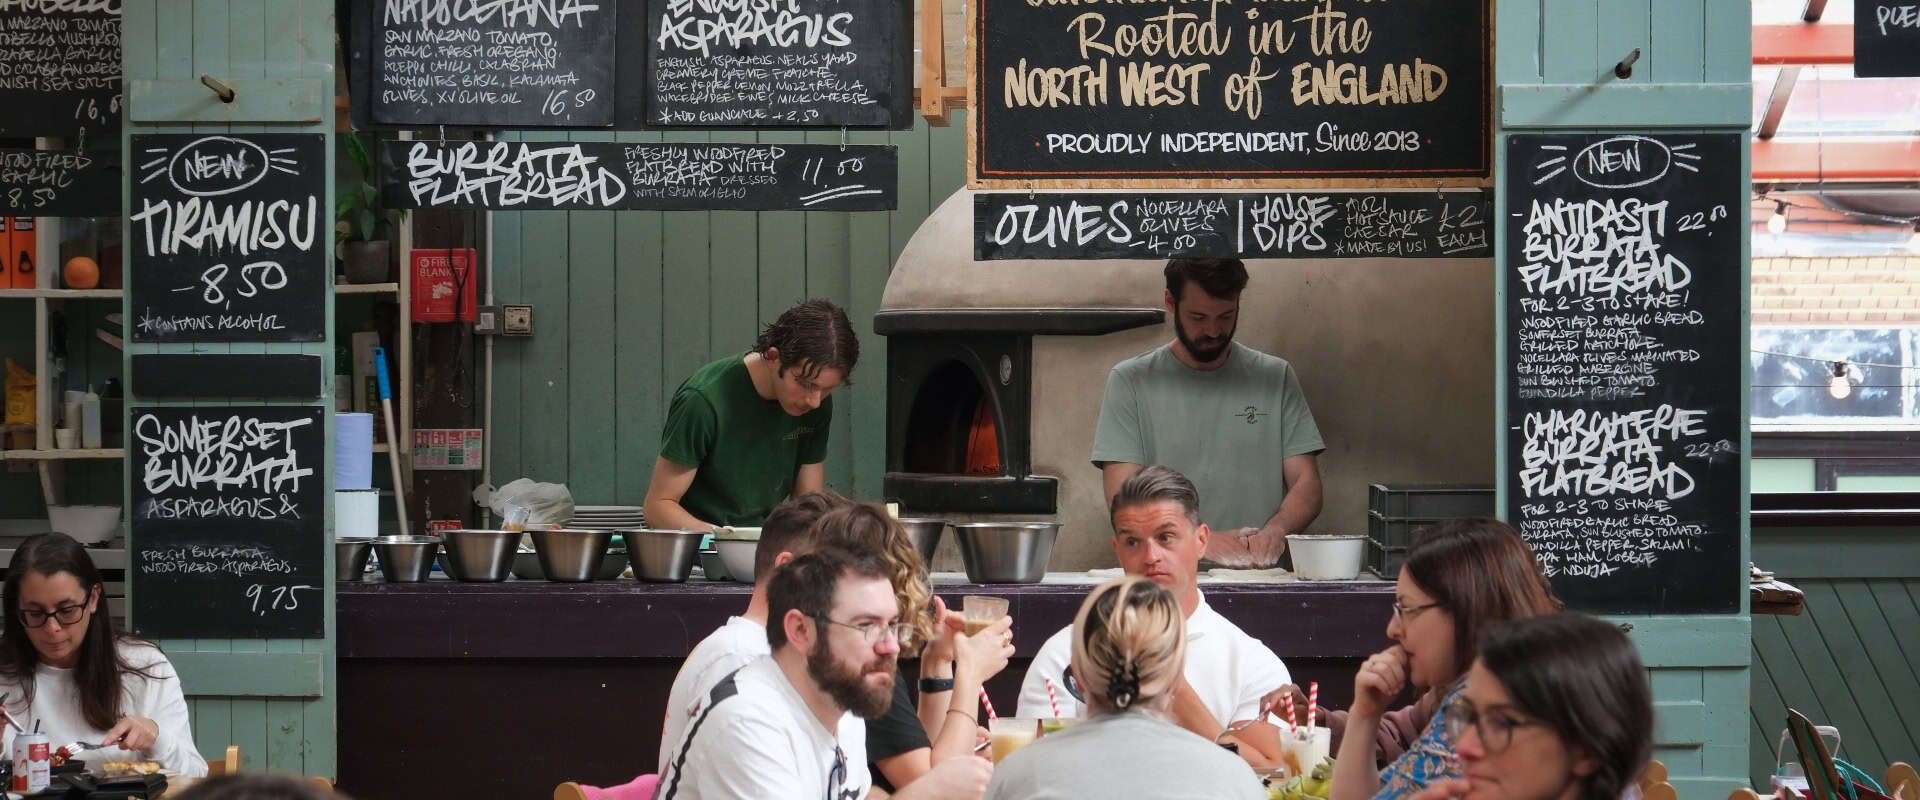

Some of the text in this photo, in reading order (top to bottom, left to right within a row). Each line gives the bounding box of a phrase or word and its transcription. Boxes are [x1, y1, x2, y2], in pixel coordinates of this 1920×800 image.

[384, 30, 412, 43] SAN
[415, 30, 481, 43] MARZANO
[657, 11, 854, 58] ASPARAGUS
[1066, 7, 1372, 60] Rooted in the
[438, 45, 484, 58] FRESH
[821, 52, 857, 68] YARD
[458, 90, 498, 105] OLIVE
[501, 92, 522, 104] OIL
[1004, 57, 1448, 120] NORTH WEST of ENGLAND
[1046, 121, 1421, 155] PROUDLY INDEPENDENT, Since 2013
[407, 142, 599, 178] BURRATA
[624, 145, 688, 160] FRESHLY
[1588, 141, 1641, 174] NEW
[184, 149, 248, 182] NEW
[626, 159, 778, 175] FLATBREAD WITH
[408, 167, 627, 207] FLATBREAD
[632, 172, 778, 187] BURRATA DRESSED
[632, 188, 665, 199] WITH
[1251, 194, 1338, 223] HOUSE
[1347, 208, 1434, 226] HOT SAUCE
[130, 195, 317, 257] TIRAMISU
[994, 198, 1229, 248] OLIVES NOCELLARA
[1139, 214, 1216, 234] OLIVES
[1344, 223, 1418, 239] CAESAR
[1253, 222, 1328, 252] DIPS
[1436, 229, 1489, 254] EACH
[1522, 226, 1661, 263] BURRATA
[420, 267, 464, 277] BLANKT
[1517, 252, 1692, 297] FLATBREAD
[1520, 297, 1553, 313] FOR
[1624, 290, 1689, 310] SHARE!
[218, 313, 285, 331] ALCOHOL
[1602, 315, 1651, 327] GARLIC
[136, 414, 313, 457] SOMERSET
[1522, 428, 1663, 469] BURRATA
[144, 449, 313, 494] BURRATA
[1519, 462, 1695, 499] FLATBREAD
[147, 494, 300, 519] ASPARAGUS &
[1521, 504, 1549, 518] FOR
[1591, 501, 1609, 511] TO
[1614, 498, 1672, 511] SHARE
[1580, 527, 1600, 538] SUN
[1633, 514, 1678, 527] BREAD
[1566, 551, 1602, 563] HAM
